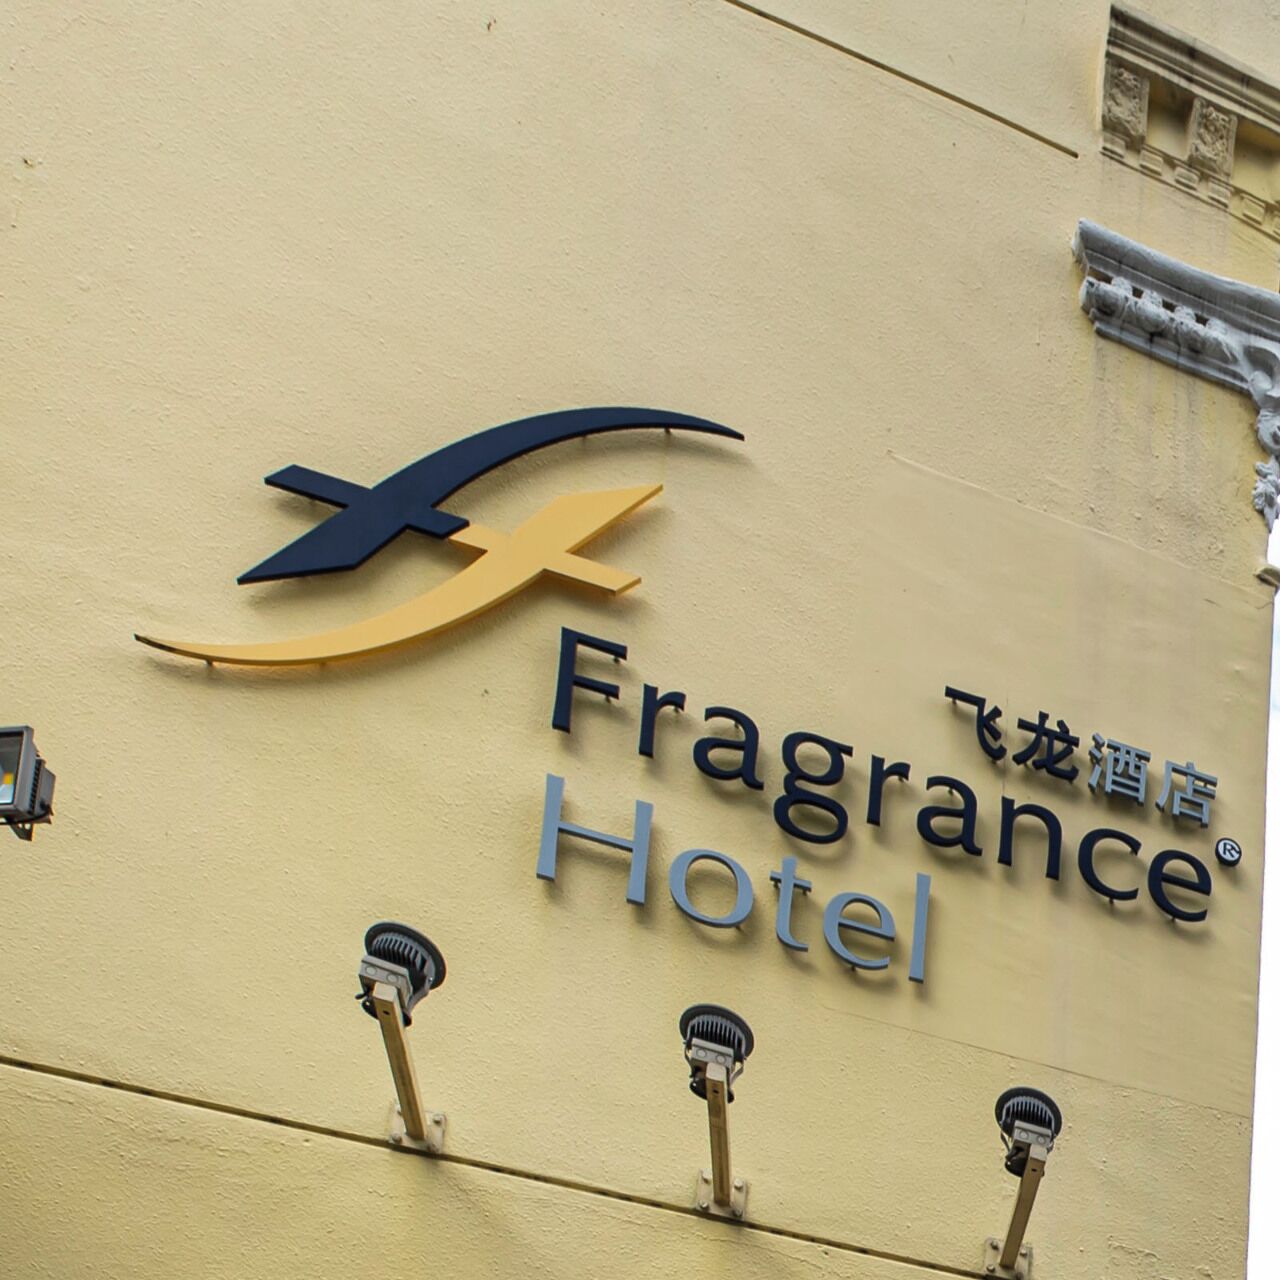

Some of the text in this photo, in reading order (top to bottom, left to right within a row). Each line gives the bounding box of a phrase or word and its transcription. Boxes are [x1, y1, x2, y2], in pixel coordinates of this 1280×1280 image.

[944, 685, 1219, 827] 飞龙酒店
[536, 774, 932, 983] Hotel
